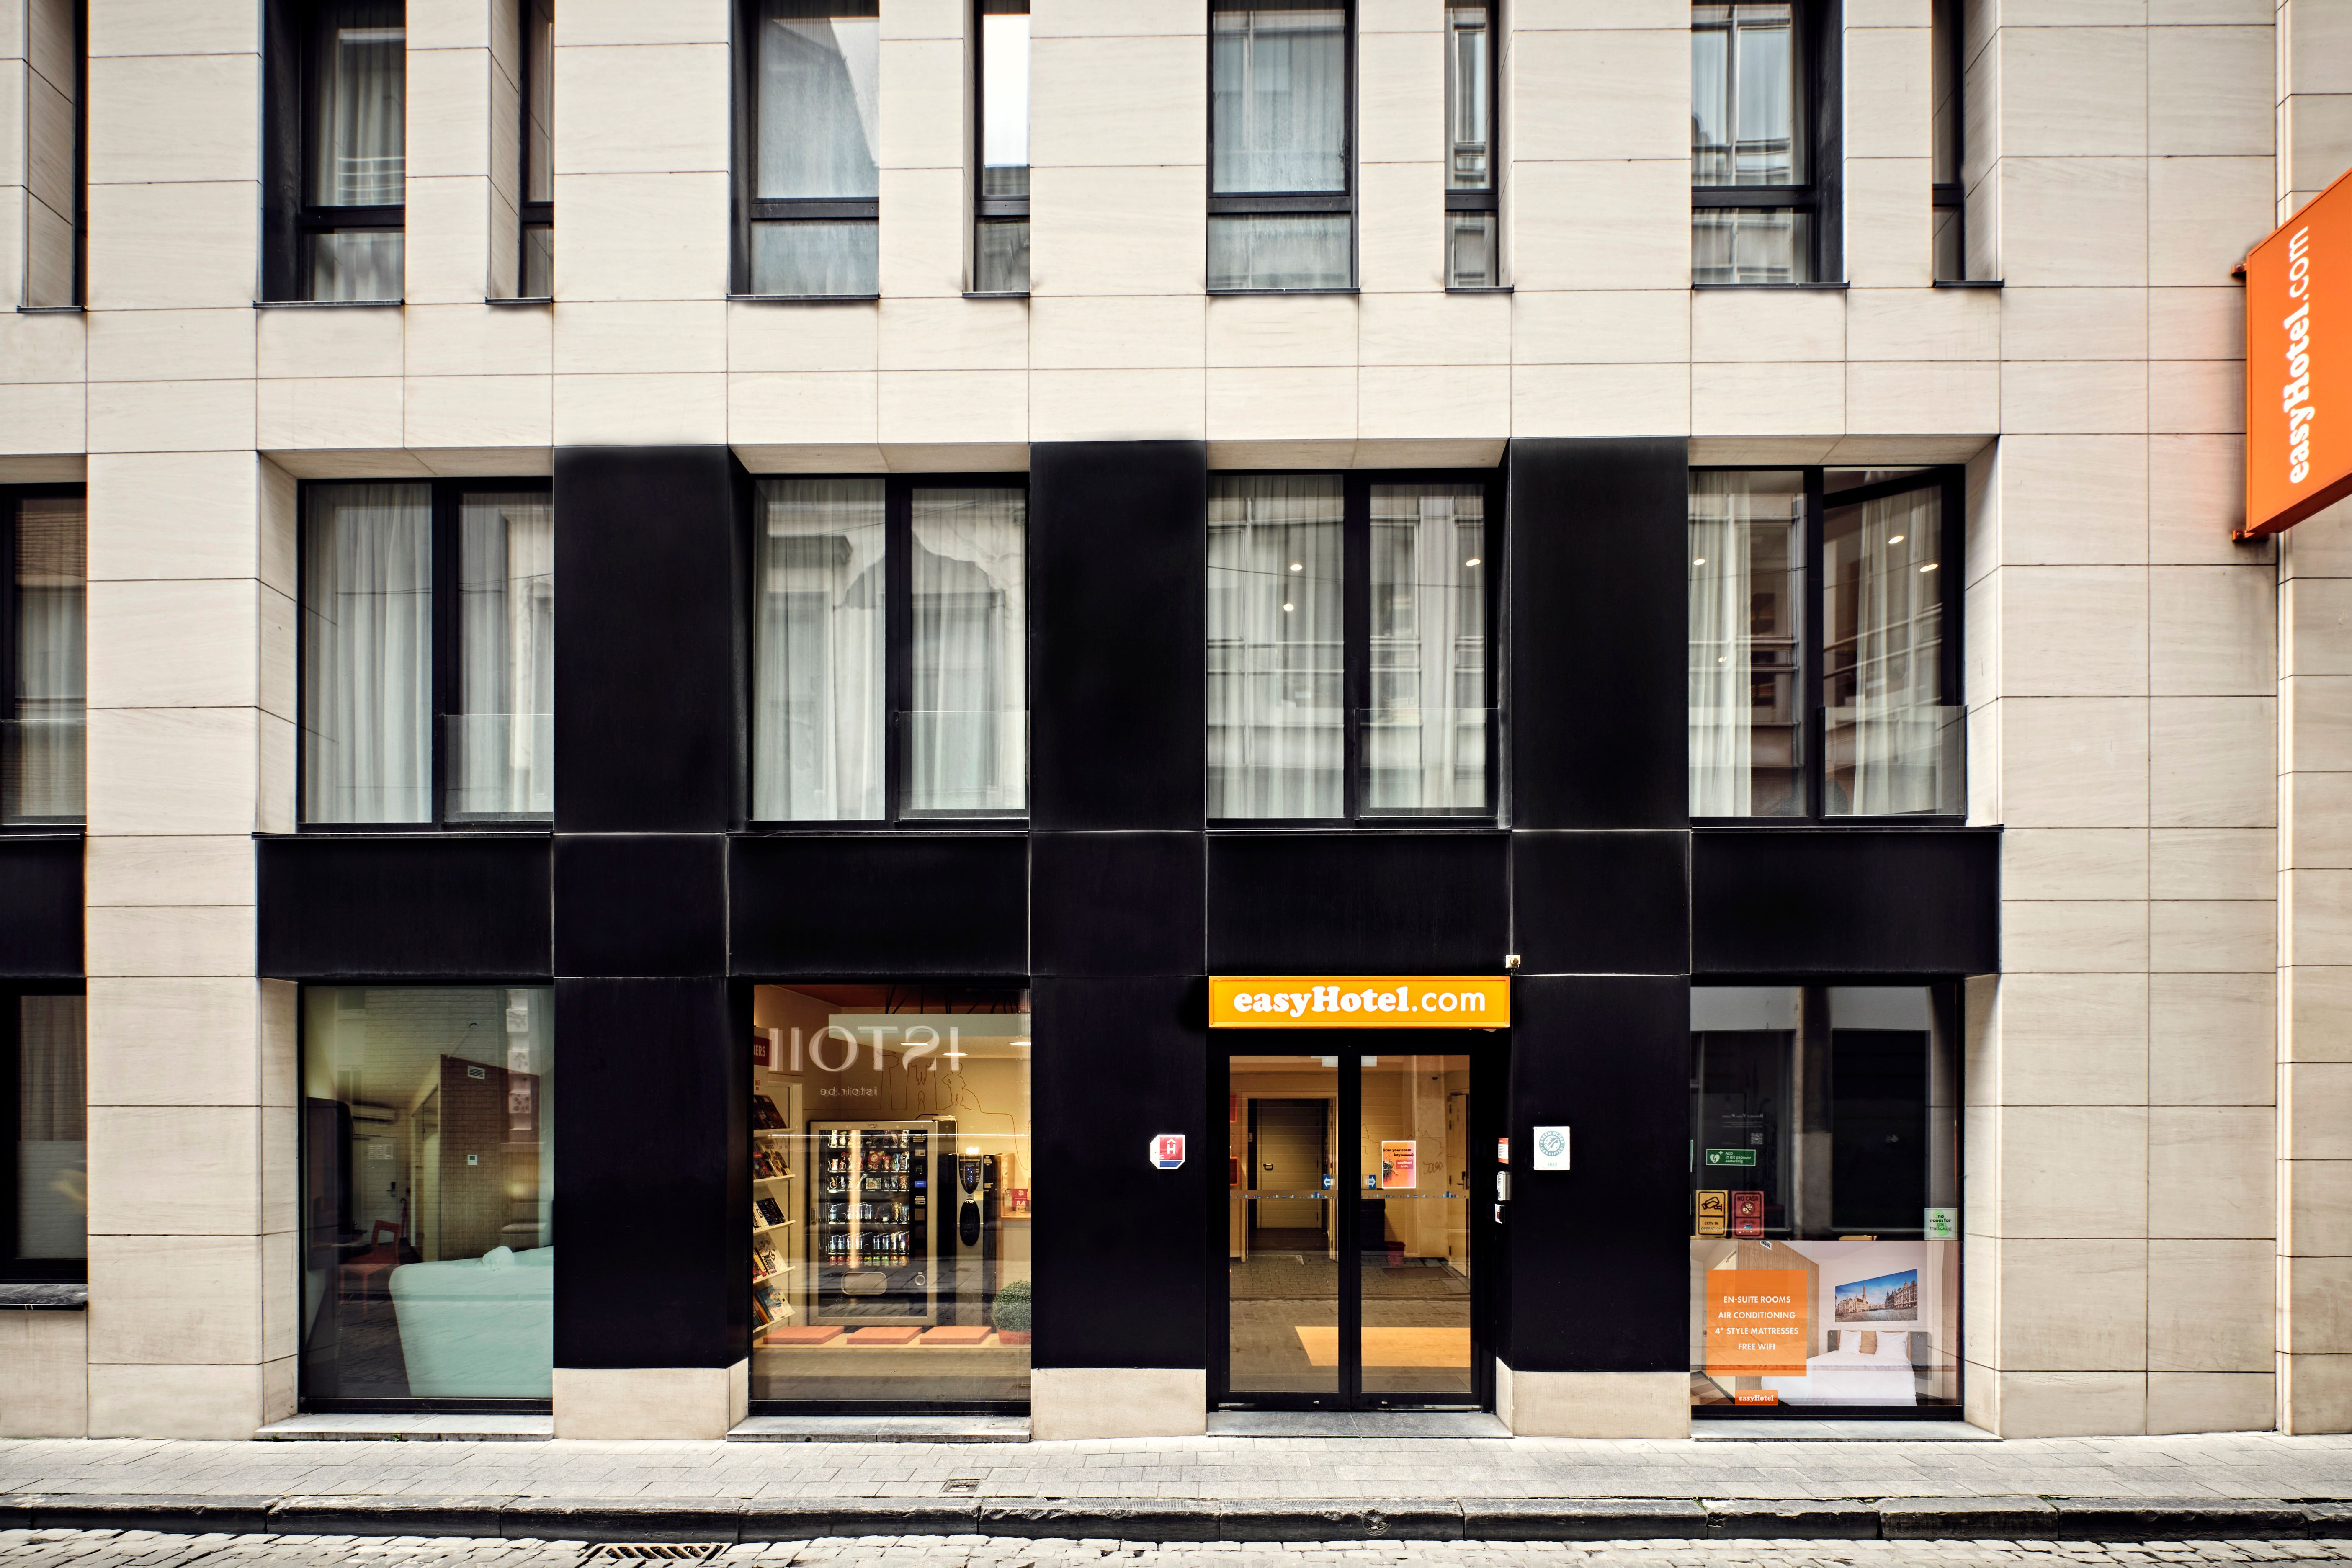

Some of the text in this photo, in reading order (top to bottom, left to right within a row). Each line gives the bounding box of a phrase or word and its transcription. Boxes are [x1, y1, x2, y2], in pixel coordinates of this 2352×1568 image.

[2283, 226, 2315, 484] easyHotel.com
[1234, 986, 1485, 1017] easyHotel.com
[1553, 1132, 1564, 1143] GLOBE
[1541, 1147, 1564, 1156] CERTIFIED
